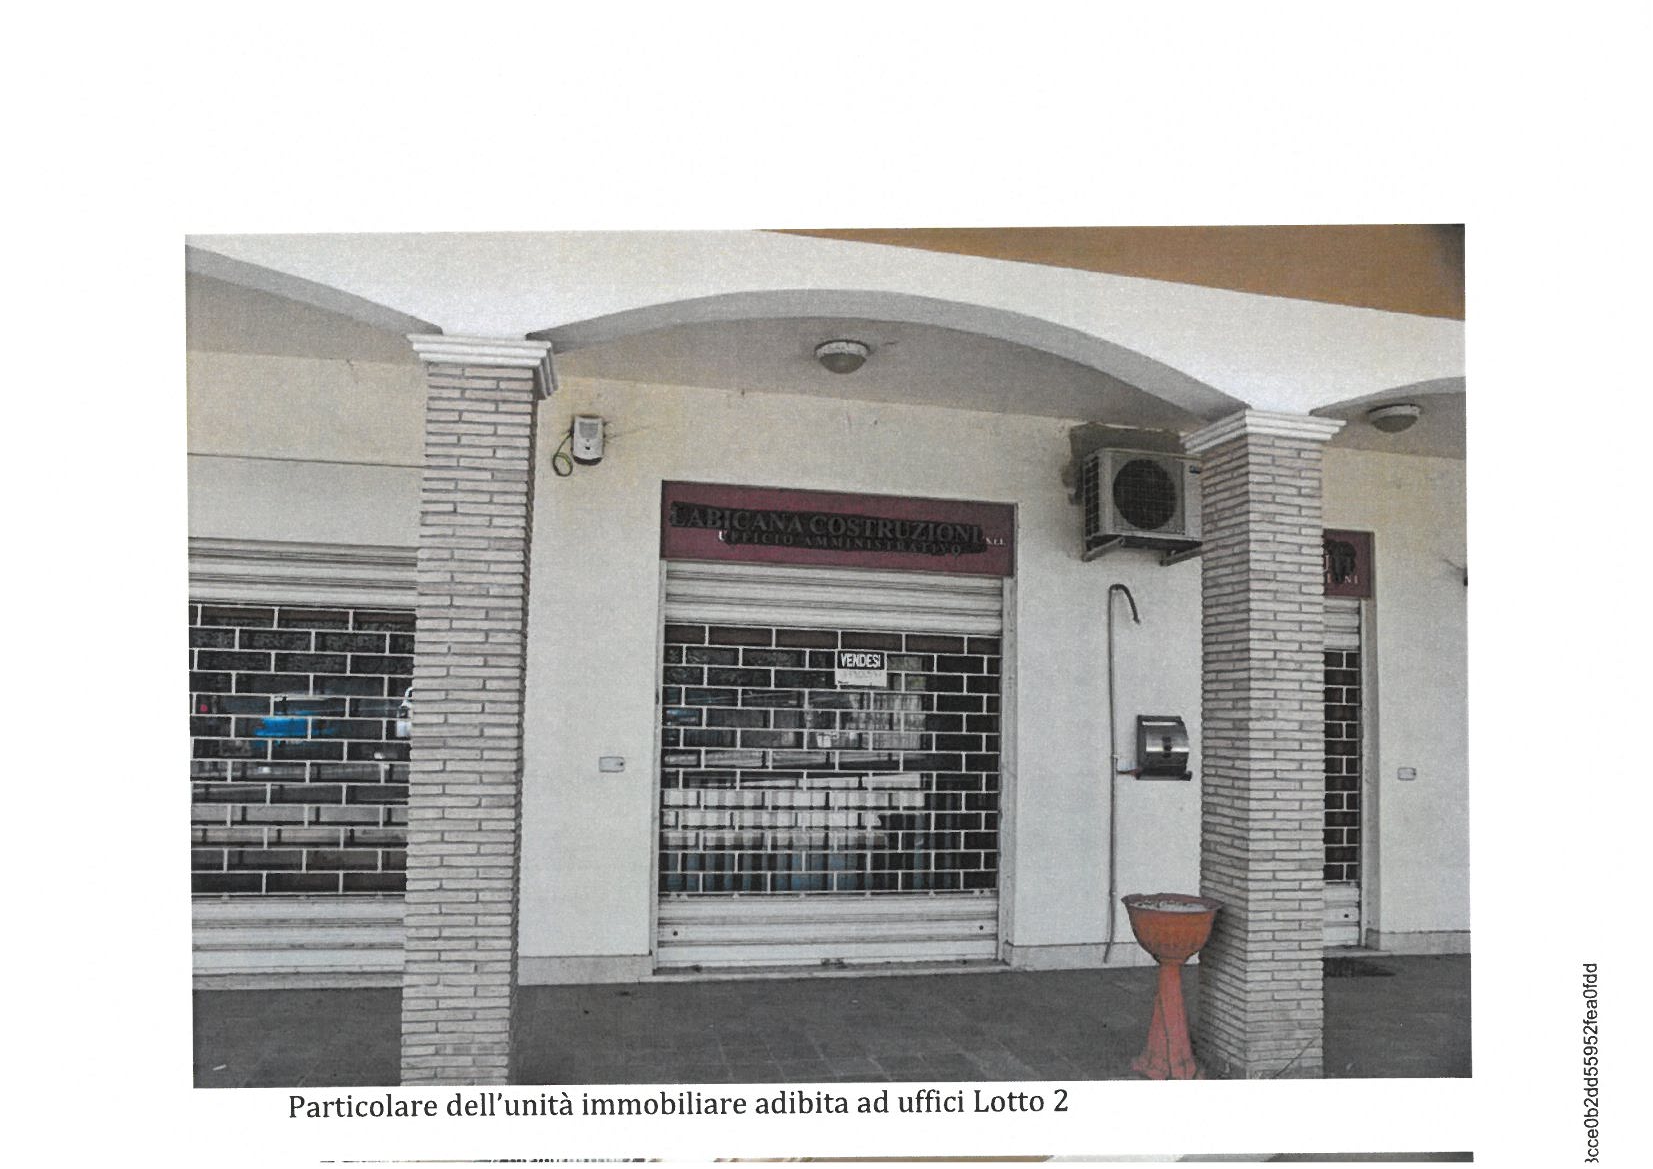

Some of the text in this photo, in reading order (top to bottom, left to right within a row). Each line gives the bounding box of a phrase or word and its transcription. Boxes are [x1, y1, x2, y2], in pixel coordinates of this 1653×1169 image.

[809, 515, 981, 544] COSTRUZIONI
[840, 652, 881, 669] VENDESI
[288, 1094, 438, 1119] Particolare
[583, 1092, 747, 1116] immobiliare
[756, 1091, 849, 1115] adibita
[858, 1090, 889, 1114] ad
[898, 1089, 965, 1113] uffici
[974, 1090, 1045, 1113] Lotto
[1054, 1089, 1069, 1112] 2
